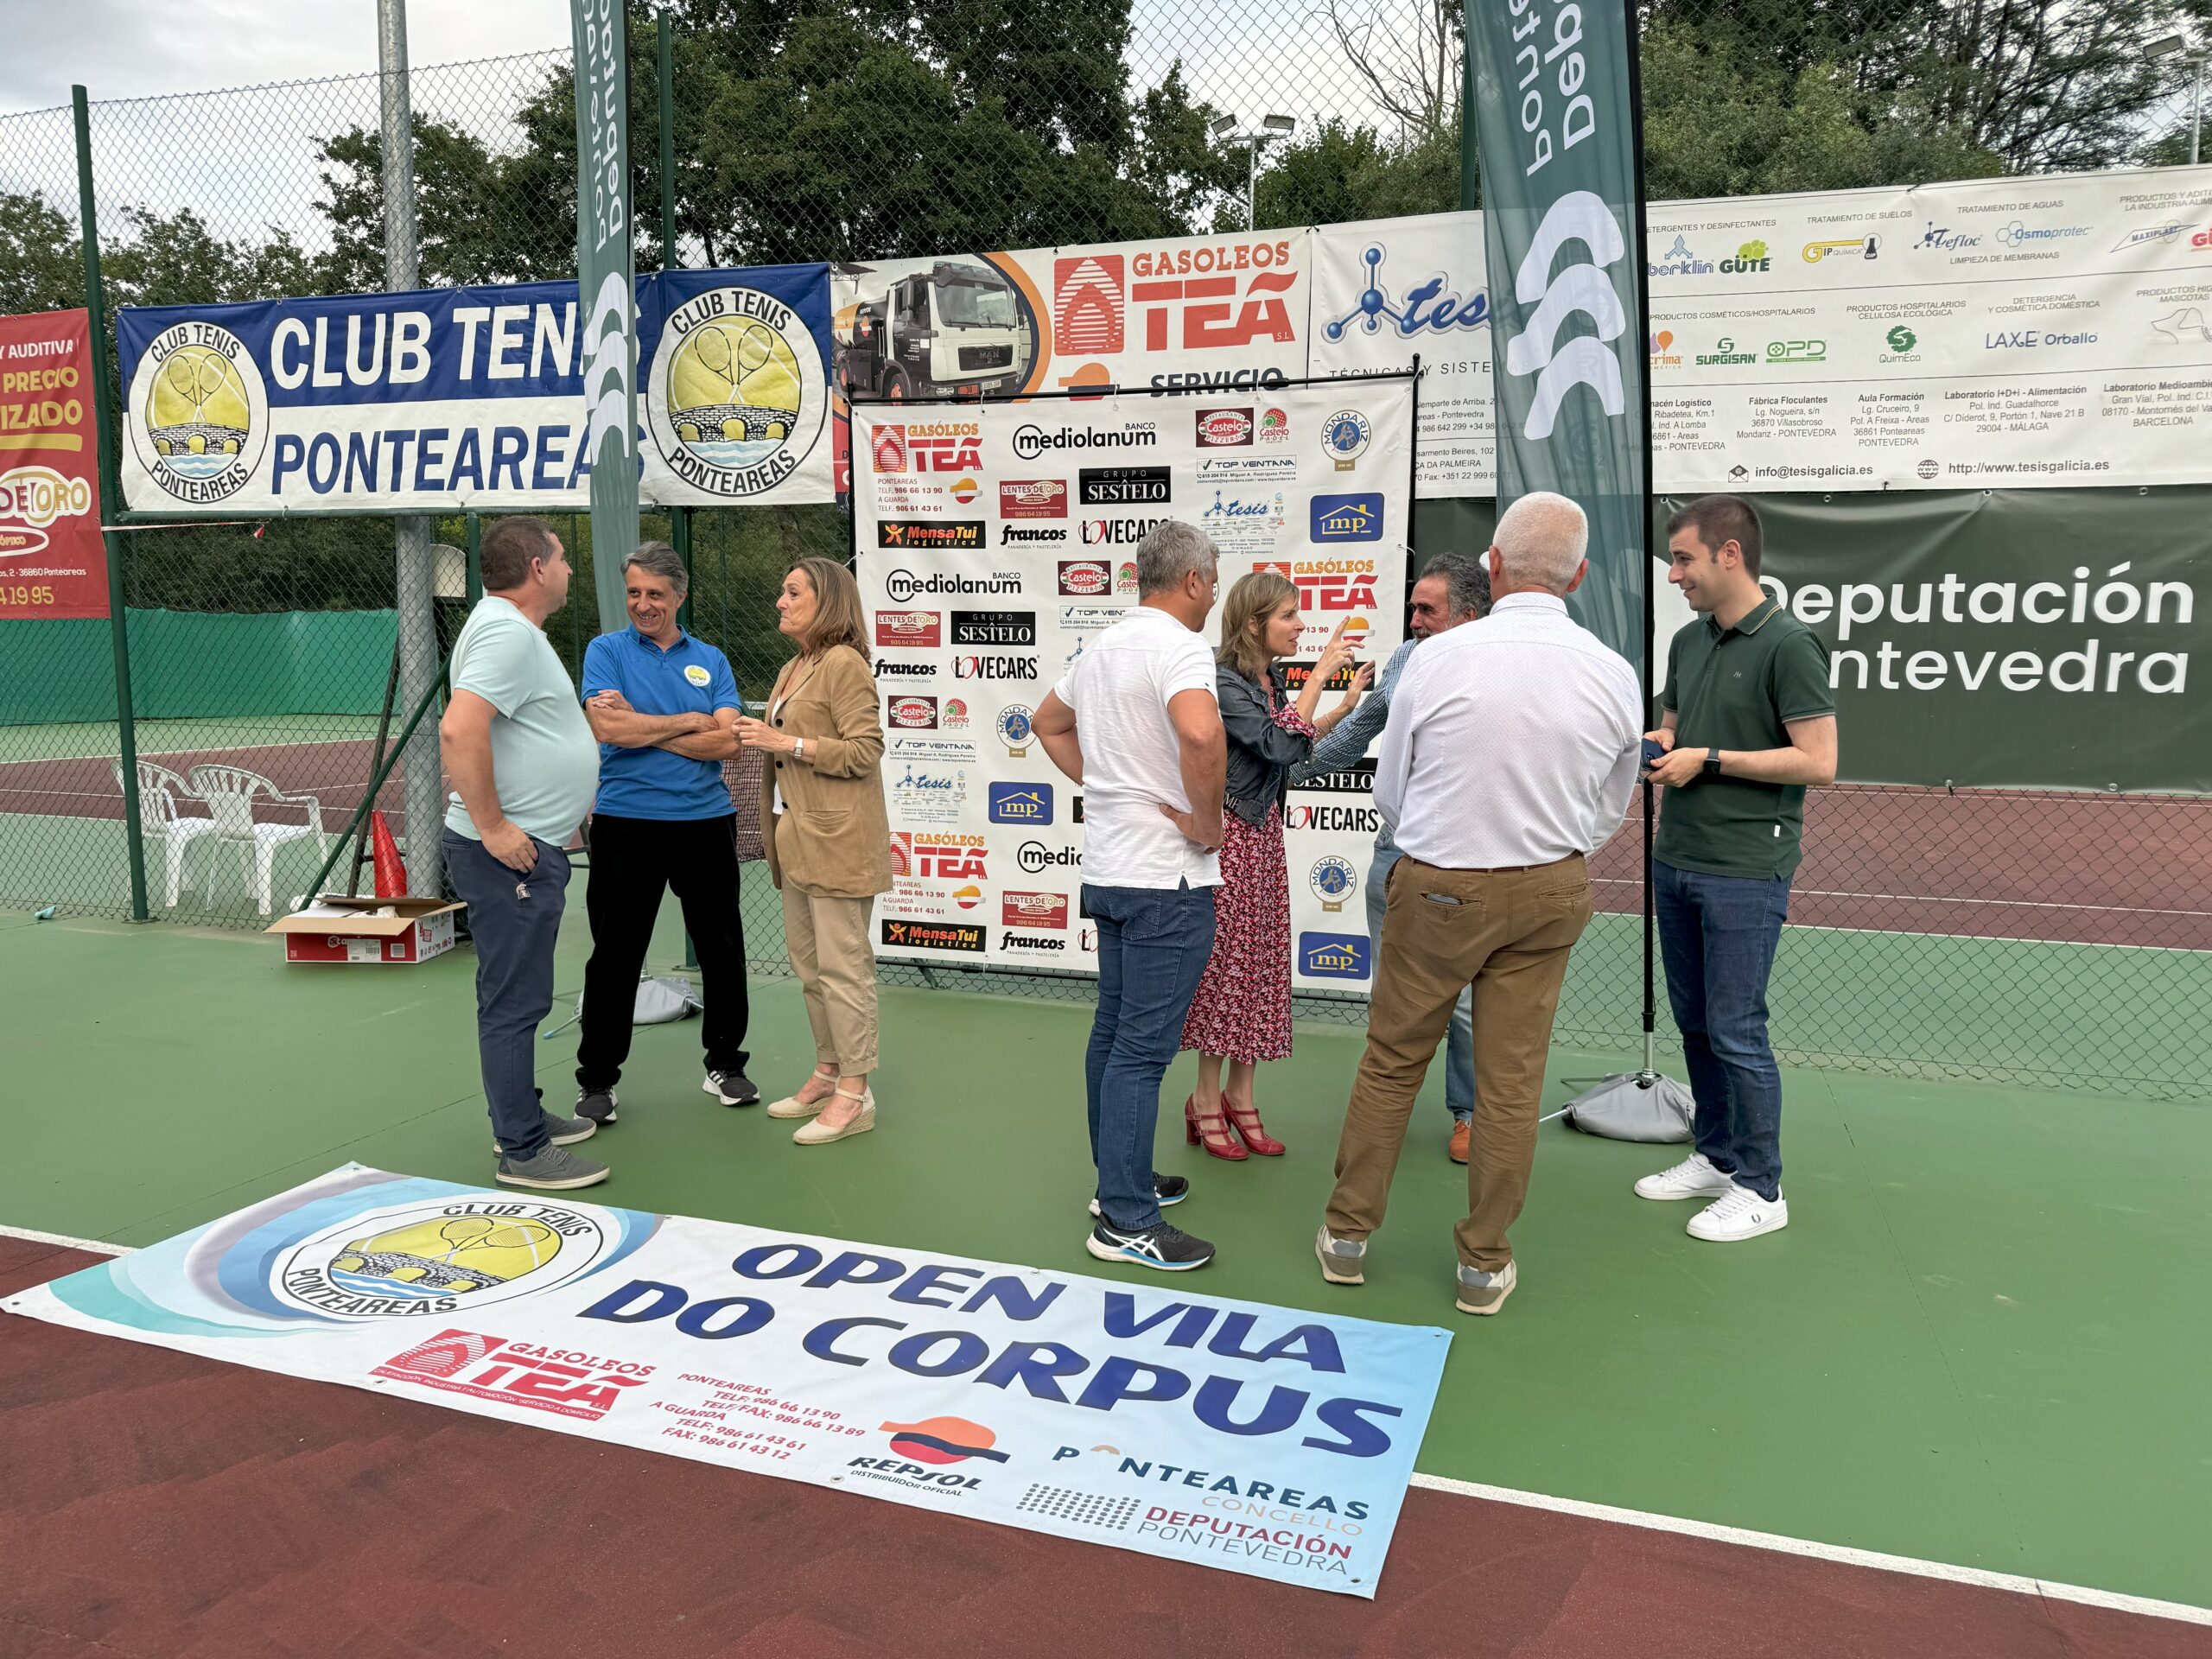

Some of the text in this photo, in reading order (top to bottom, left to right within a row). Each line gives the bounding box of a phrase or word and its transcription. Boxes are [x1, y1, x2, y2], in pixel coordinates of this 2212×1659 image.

[1958, 204, 2017, 213] TRATAMIENTO
[2032, 200, 2064, 209] AGUAS
[1707, 219, 1777, 229] DESINFECTANTES
[1808, 214, 1863, 224] TRATAMIENTO
[2015, 226, 2089, 239] Osmoprotec
[1133, 241, 1289, 276] GASOLEOS
[1950, 256, 1988, 264] LIMPIEZA
[2004, 251, 2060, 261] MEMBRANAS
[1401, 278, 1491, 334] tes
[1847, 301, 1966, 313] PRODUCTOS HOSPITALARIOS
[2013, 294, 2076, 304] DETERGENCIA
[671, 290, 791, 335] CLUB TENIS
[1904, 308, 1953, 318] ECOLÓGICA
[150, 324, 241, 364] CLUB TENIS
[270, 302, 640, 390] CLUB TEN
[2044, 333, 2098, 345] Orballo
[8, 339, 73, 359] AUDITIVA
[1695, 353, 1756, 365] SURGISAN
[1879, 353, 1921, 363] QuimEco
[3, 366, 79, 393] PRECIO
[1150, 367, 1284, 397] SERVICIO
[2104, 383, 2156, 391] Laboratorio
[1879, 392, 1924, 401] Formación
[1945, 385, 2087, 399] Laboratorio Alimentación
[1877, 404, 1911, 413] Cruceiro,
[2005, 399, 2059, 409] Guadalhorce
[908, 421, 979, 437] GASÓLEOS
[1207, 420, 1243, 432] Castelo
[1325, 413, 1368, 444] MONDARIZ
[2133, 416, 2194, 427] BARCELONA
[1019, 427, 1156, 449] mediolanum
[1260, 427, 1289, 436] Castelo
[1778, 429, 1836, 437] PONTEVEDRA
[668, 446, 797, 493] PONTEAREAS
[1755, 465, 1872, 479] info@tesisgalicia.es
[1948, 460, 2109, 474] http://www.tesisgalicia.es
[150, 459, 249, 502] PONTEAREAS
[1088, 479, 1166, 500] SESTELO
[1228, 500, 1269, 515] tesis
[907, 526, 977, 538] MensaTui
[1329, 518, 1366, 533] mp
[1001, 524, 1067, 545] francos
[19, 569, 43, 577] 36860
[1294, 557, 1374, 574] GASÓLEOS
[892, 574, 1021, 594] mediolanum
[958, 623, 1031, 642] SESTELO
[874, 658, 937, 678] francos
[1829, 639, 2189, 693] ntevedra
[1005, 803, 1038, 817] mp
[913, 831, 985, 847] GASÓLEOS
[1313, 858, 1354, 887] MONDARIZ
[909, 926, 978, 942] MensaTui
[1000, 931, 1065, 950] francos
[442, 1204, 593, 1237] CLUB TENIS
[287, 1268, 457, 1314] PONTEAREAS
[732, 1243, 1346, 1374] OPEN VILA
[508, 1343, 657, 1376] GASOLEOS
[575, 1279, 1403, 1458] DO CORPUS
[677, 1373, 772, 1395] PONTEAREAS
[714, 1391, 779, 1406] TELF: 986
[664, 1404, 727, 1421] GUARDA
[702, 1401, 800, 1424] TELF/FAX: 986
[662, 1427, 697, 1440] FAX:
[847, 1457, 982, 1491] REPSOL
[850, 1470, 963, 1497] DISTRIBUIDOR OFICIAL
[1201, 1496, 1363, 1536] CONCELLO
[1145, 1506, 1352, 1560] DEPUTACIÓN
[1136, 1521, 1348, 1575] PONTEVEDRA
